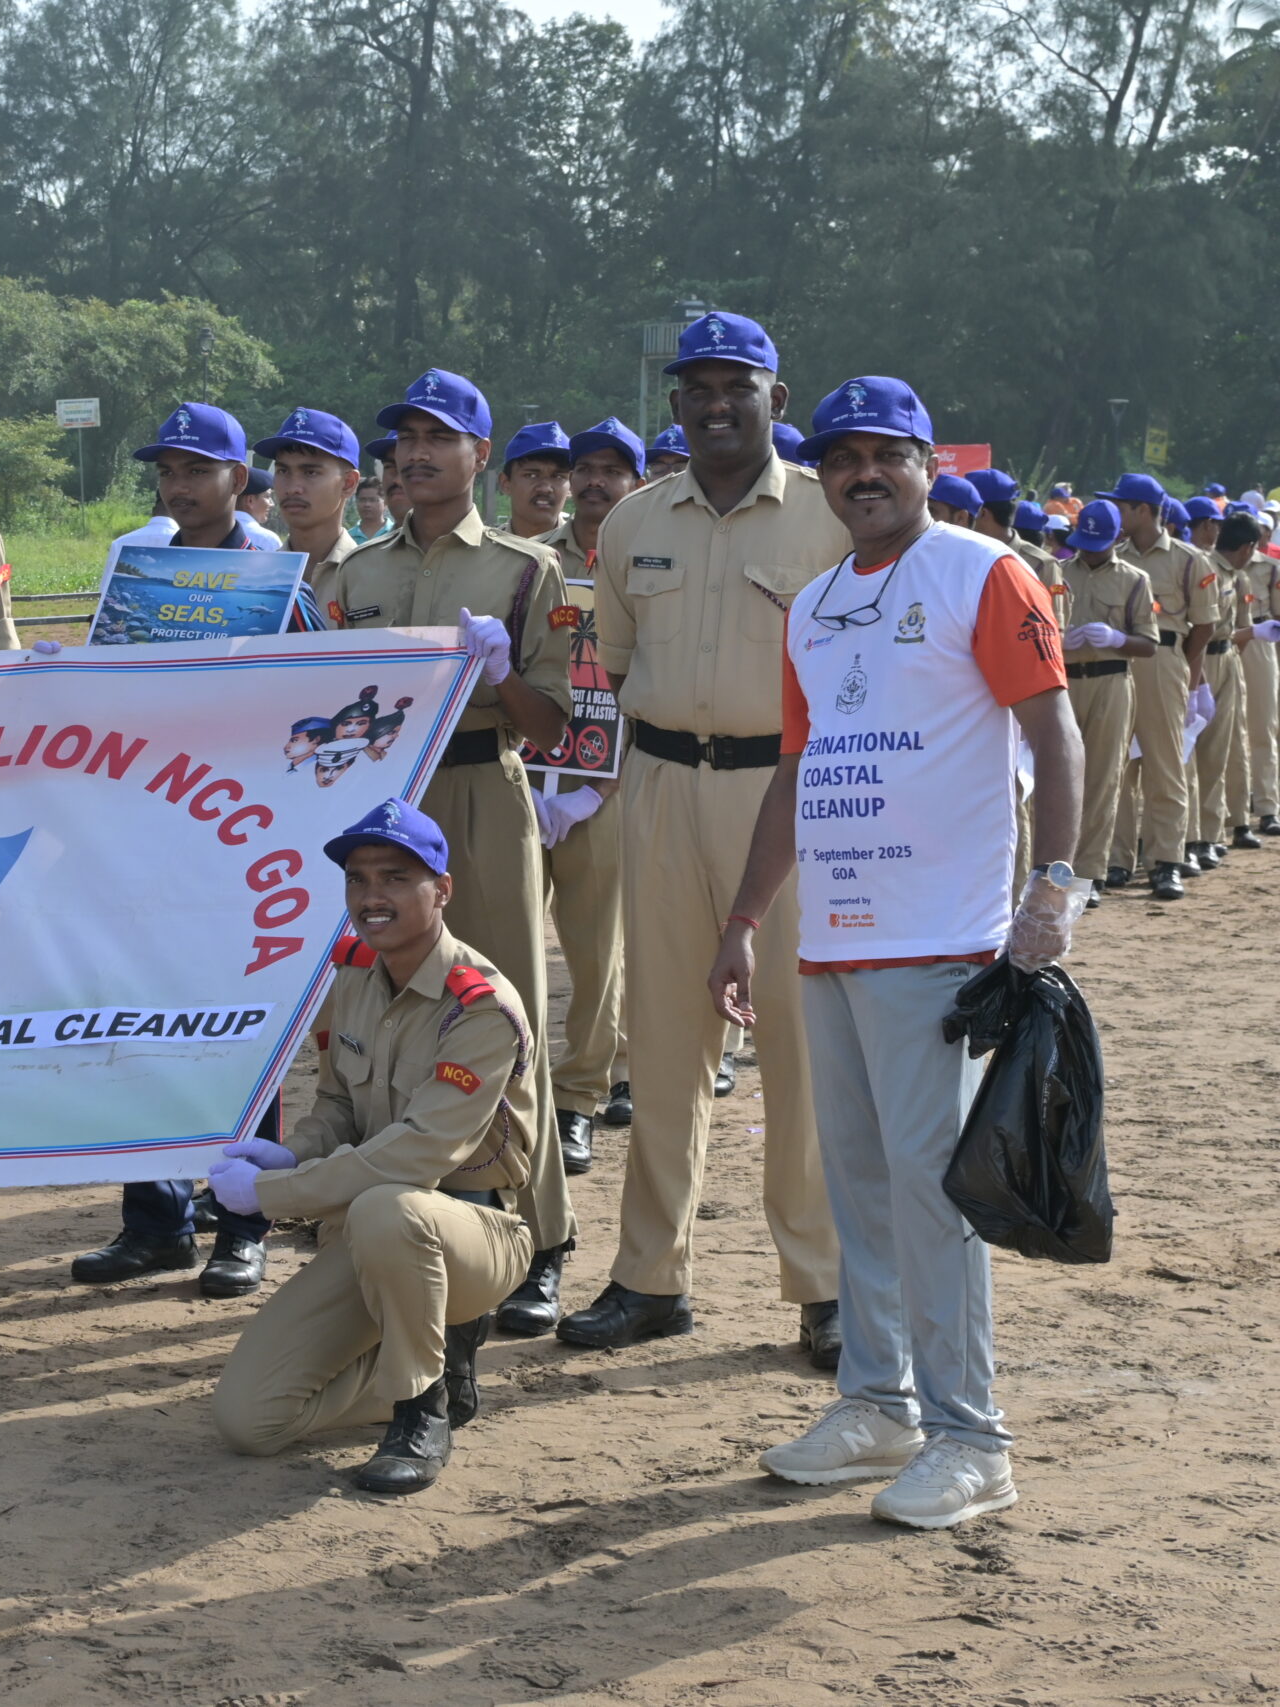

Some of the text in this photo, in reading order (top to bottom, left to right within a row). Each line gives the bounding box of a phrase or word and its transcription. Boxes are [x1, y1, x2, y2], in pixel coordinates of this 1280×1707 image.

[173, 570, 240, 590] SAVE
[188, 593, 213, 603] OUR
[158, 604, 229, 627] SEAS,
[552, 609, 575, 625] NCC
[150, 628, 229, 640] PROTECT OUR
[586, 690, 591, 703] A
[574, 703, 617, 721] OF PLASTIC
[803, 764, 884, 788] COASTAL
[801, 797, 886, 820] CLEANUP
[145, 752, 275, 847] NCC
[244, 848, 310, 976] GOA
[813, 847, 874, 864] September
[878, 845, 912, 860] 2025
[832, 867, 857, 880] GOA
[829, 896, 871, 906] supported by
[54, 1009, 266, 1041] CLEANUP
[443, 1065, 473, 1087] NCC
